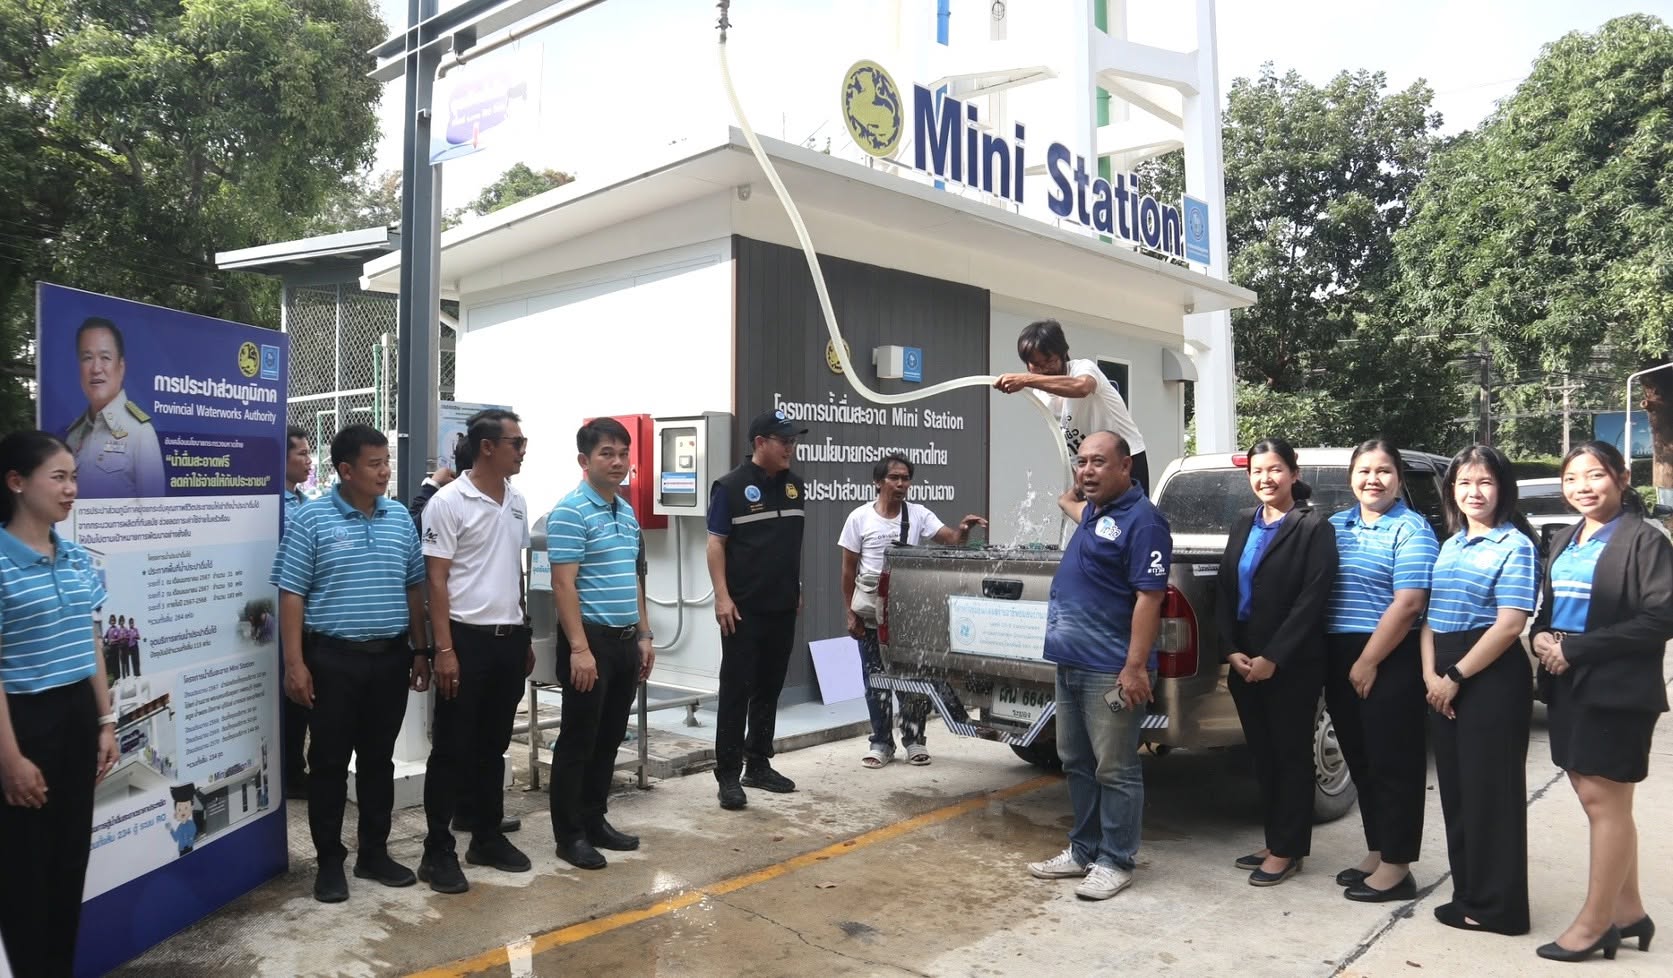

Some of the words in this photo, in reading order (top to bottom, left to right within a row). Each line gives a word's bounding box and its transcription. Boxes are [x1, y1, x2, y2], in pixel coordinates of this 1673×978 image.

[913, 82, 1025, 205] Mini
[1046, 141, 1182, 257] Station
[154, 374, 277, 405] การประปาส่วนภูมิภาค
[154, 400, 194, 415] Provincial
[196, 403, 242, 420] Waterworks
[244, 409, 276, 425] Authority
[774, 392, 887, 425] โครงการน้ำดื่มสะอาด
[892, 407, 918, 428] Mini
[924, 408, 964, 430] Station
[1150, 550, 1162, 567] 2
